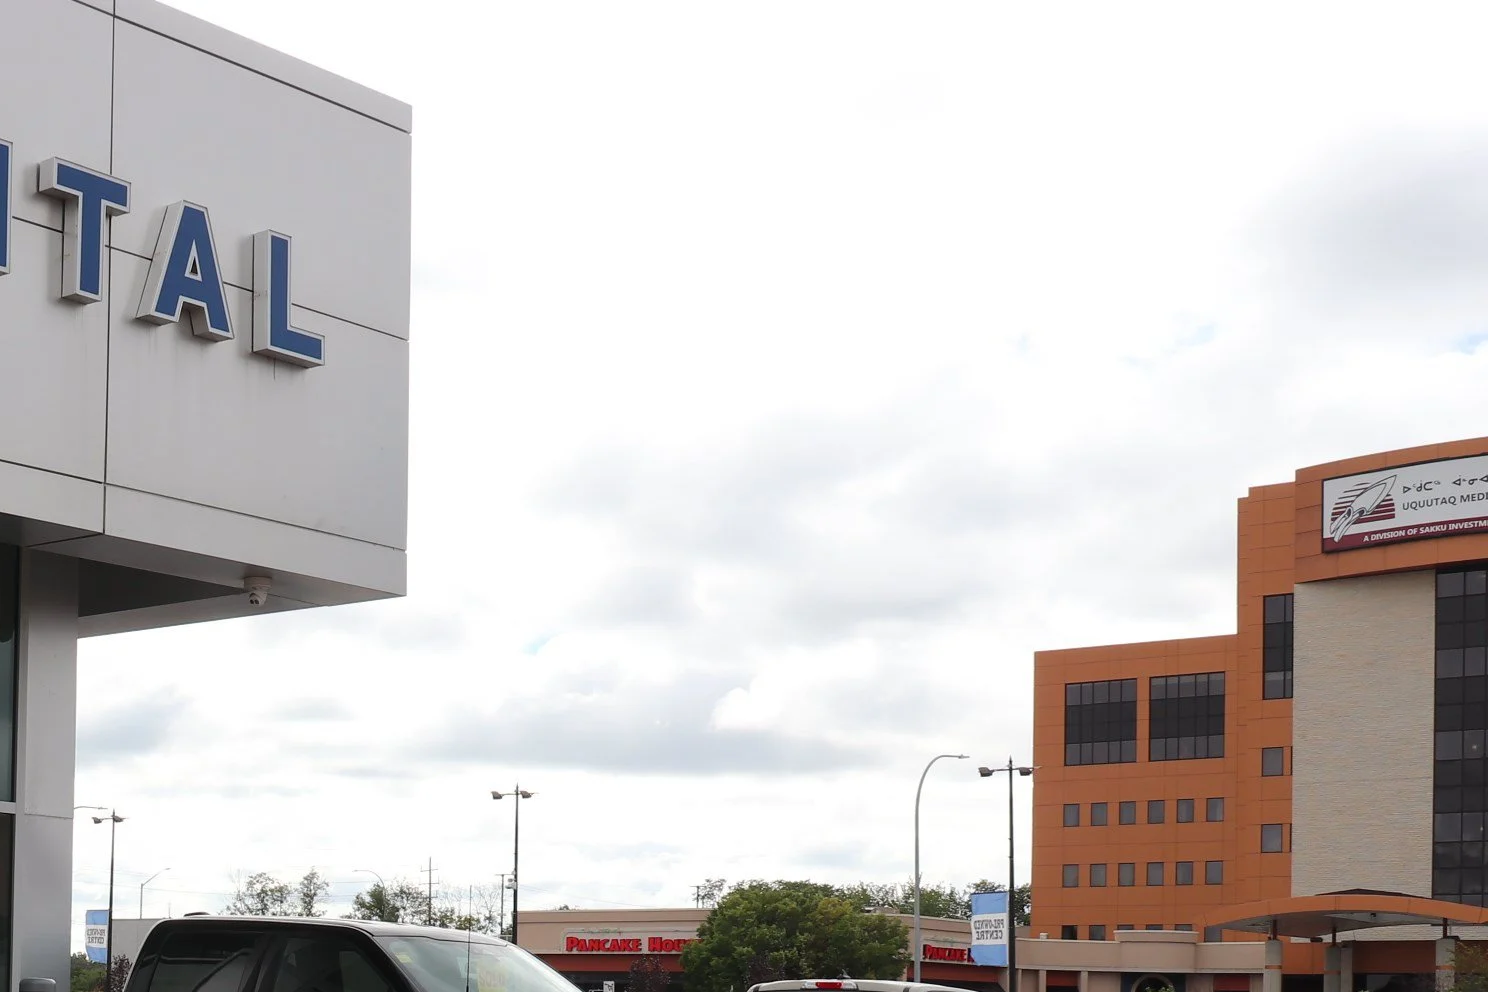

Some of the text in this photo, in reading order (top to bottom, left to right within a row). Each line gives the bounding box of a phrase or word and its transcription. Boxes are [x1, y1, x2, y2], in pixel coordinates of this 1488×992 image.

[1402, 495, 1457, 511] UQUUTAQ
[1363, 535, 1370, 543] A
[1370, 529, 1406, 542] DIVISION
[1407, 527, 1419, 536] OF
[1419, 523, 1448, 535] SAKKU
[565, 936, 705, 953] PANCAKE HOU
